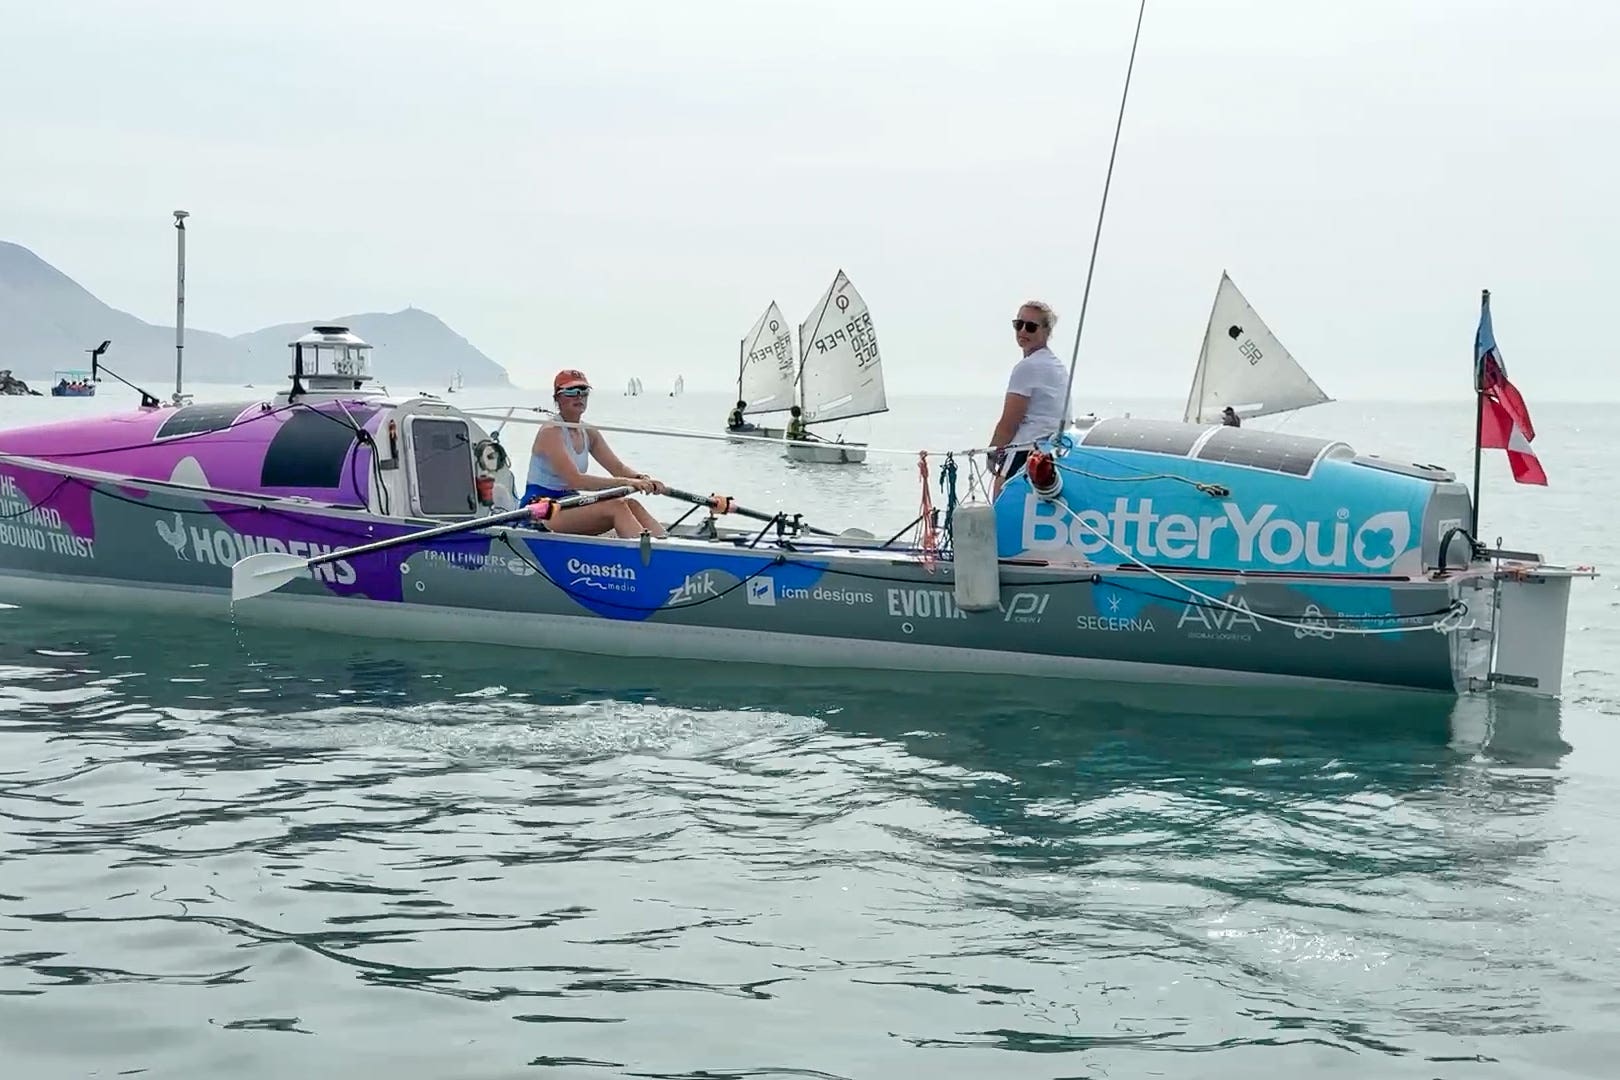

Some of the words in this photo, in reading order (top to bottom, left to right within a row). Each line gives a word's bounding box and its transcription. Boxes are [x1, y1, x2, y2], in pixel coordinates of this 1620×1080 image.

[846, 312, 873, 338] PER
[0, 475, 17, 497] HE
[0, 524, 46, 551] BOUND
[47, 532, 95, 559] TRUST
[423, 550, 507, 567] TRAILFINDERS
[567, 558, 636, 580] Coastin
[608, 582, 636, 592] media
[781, 585, 809, 600] icm
[813, 588, 874, 604] designs
[1076, 615, 1156, 632] SECERNA
[1177, 594, 1263, 632] AVA
